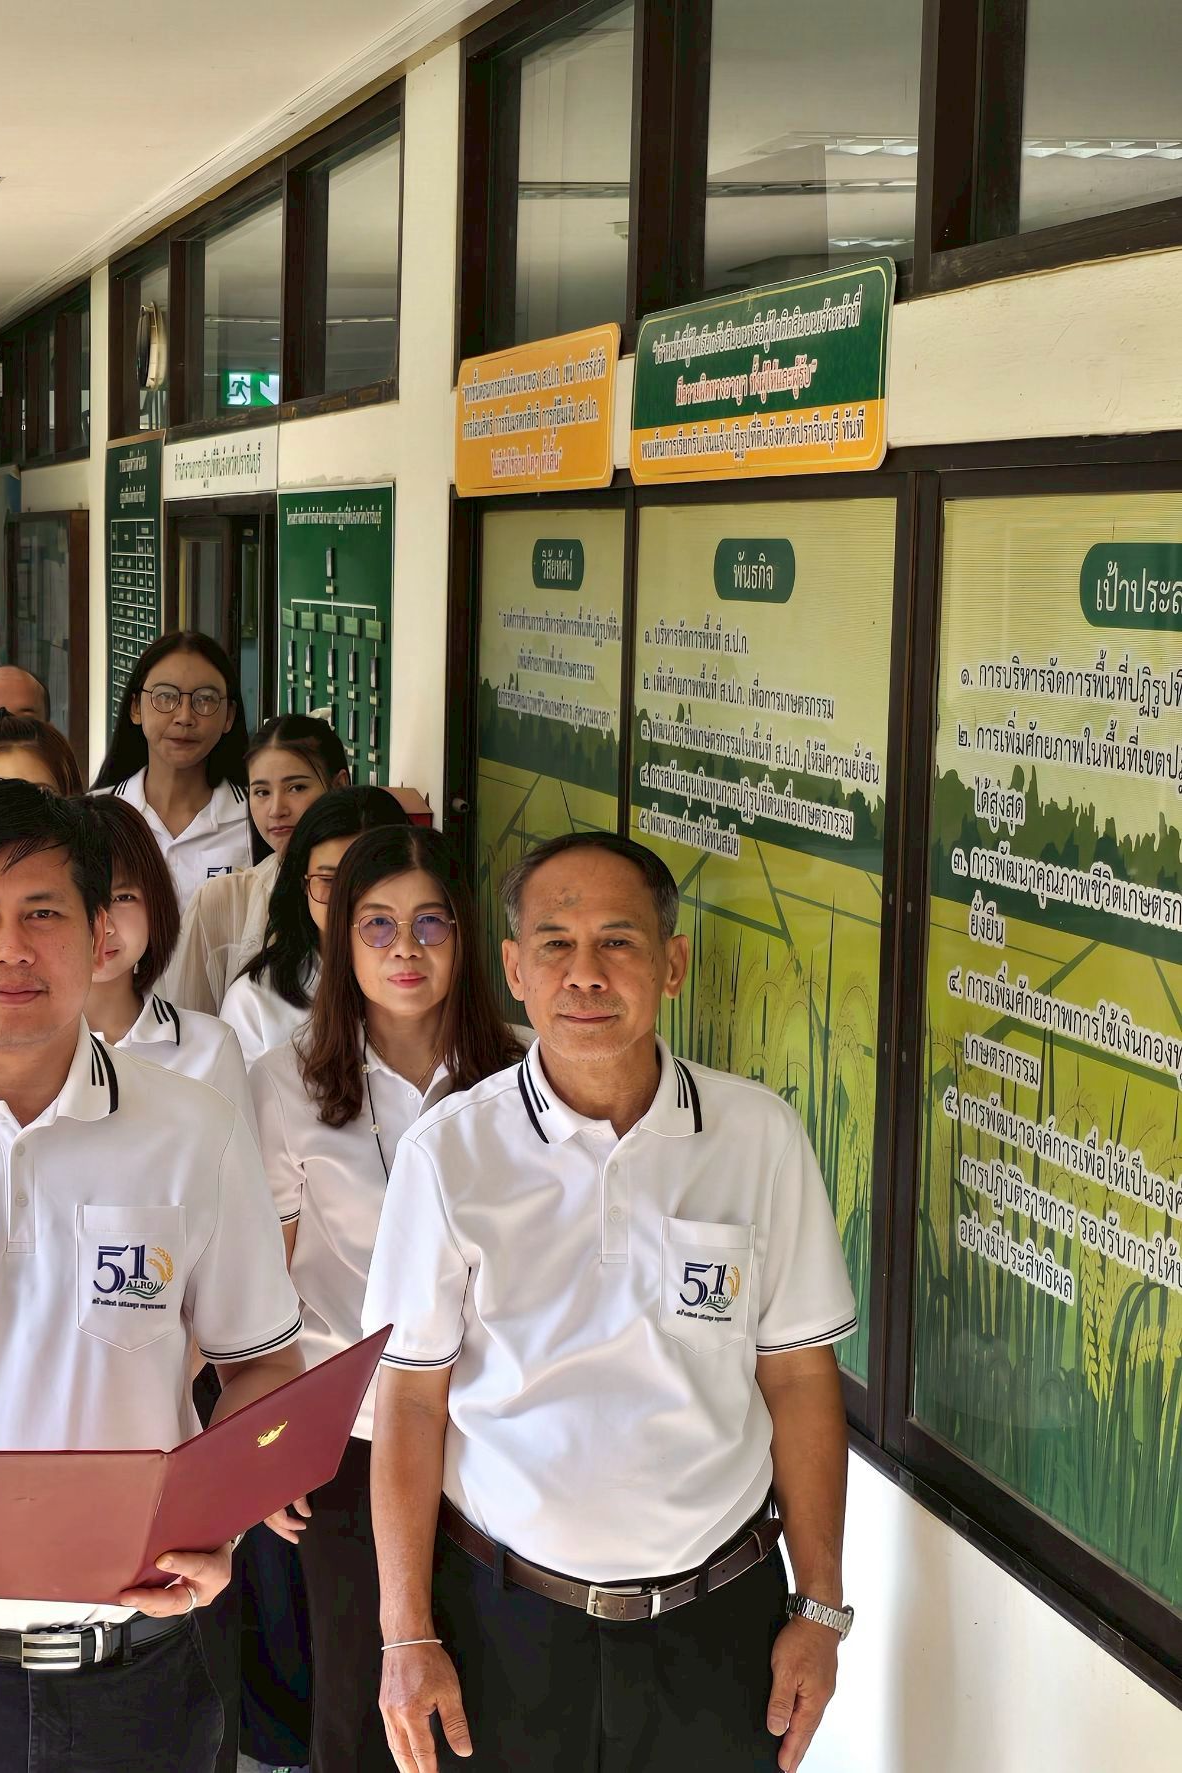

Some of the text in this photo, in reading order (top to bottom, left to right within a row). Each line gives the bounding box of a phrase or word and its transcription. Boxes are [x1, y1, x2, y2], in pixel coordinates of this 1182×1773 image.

[843, 408, 865, 439] ทันที
[541, 549, 573, 580] วิสัยทัศน์
[733, 552, 774, 590] พันธกิจ
[655, 615, 721, 650] บริหารจัดการพื้นที่
[724, 632, 749, 654] ส.ป.ก.
[653, 661, 717, 699] เพิ่มศักยภาพพื้นที่
[720, 680, 744, 704] ส.ป.ก.
[749, 674, 834, 720] เพื่อการเกษตรกรรม
[652, 714, 772, 760] พัฒนาอาชีพเกษตรกรรมในพื้นที่
[775, 741, 803, 768] ส.ป.ก.
[807, 740, 880, 785] ให้มีความยั่งยืน
[975, 776, 1024, 831] ได้สูงสุด
[971, 892, 1004, 945] ยั่งยืน
[965, 1035, 1039, 1086] เกษตรกรรม
[961, 1158, 1074, 1234] การปฏิบัติราชการ
[93, 1244, 149, 1294] 51
[679, 1262, 727, 1307] 51
[960, 1217, 1072, 1302] อย่างมีประสิทธิผล
[126, 1280, 154, 1290] ALRO
